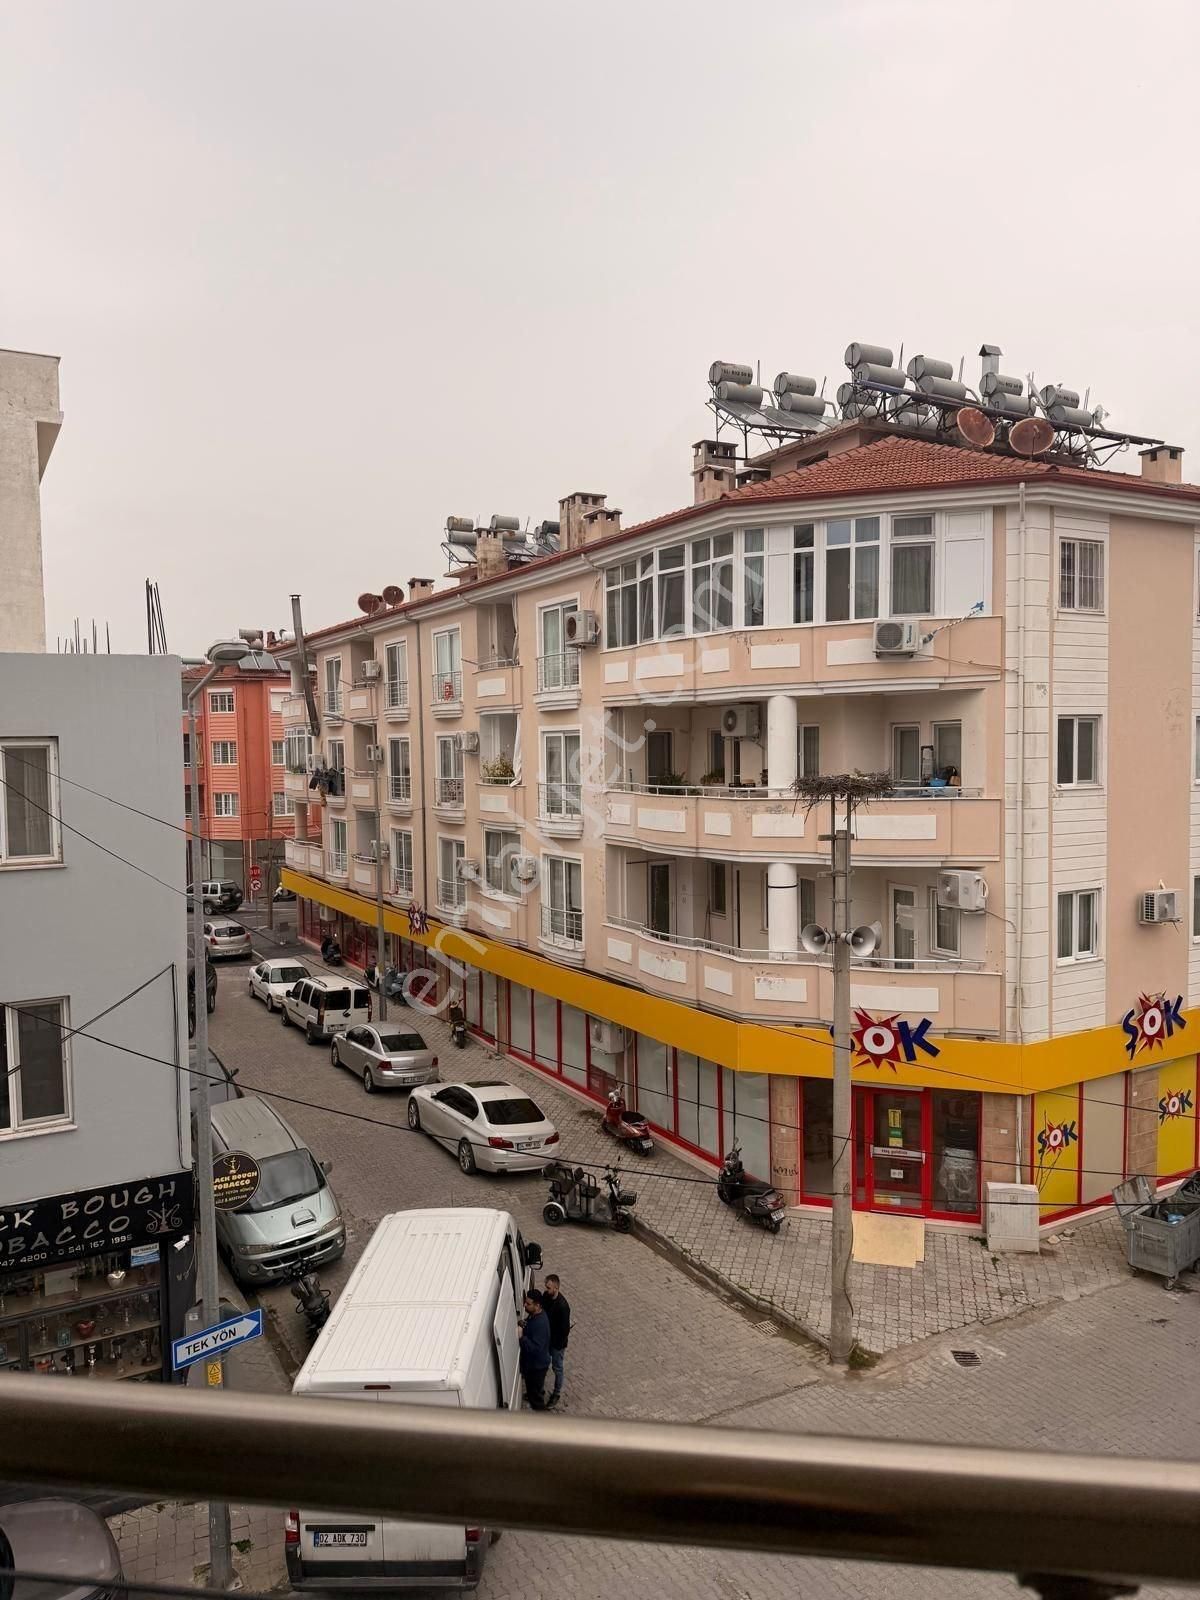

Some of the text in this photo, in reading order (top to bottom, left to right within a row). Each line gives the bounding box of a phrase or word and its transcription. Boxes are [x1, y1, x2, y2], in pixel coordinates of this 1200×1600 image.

[213, 1178, 251, 1191] TOBACCO
[214, 1171, 258, 1184] ACK BOUGH
[61, 1181, 176, 1220] BOUGH
[0, 1216, 130, 1255] BACCO
[20, 1252, 48, 1263] 4200
[68, 1244, 85, 1254] 541
[185, 1327, 237, 1356] TEK YÖN
[320, 1534, 328, 1543] 02
[351, 1534, 364, 1543] 730
